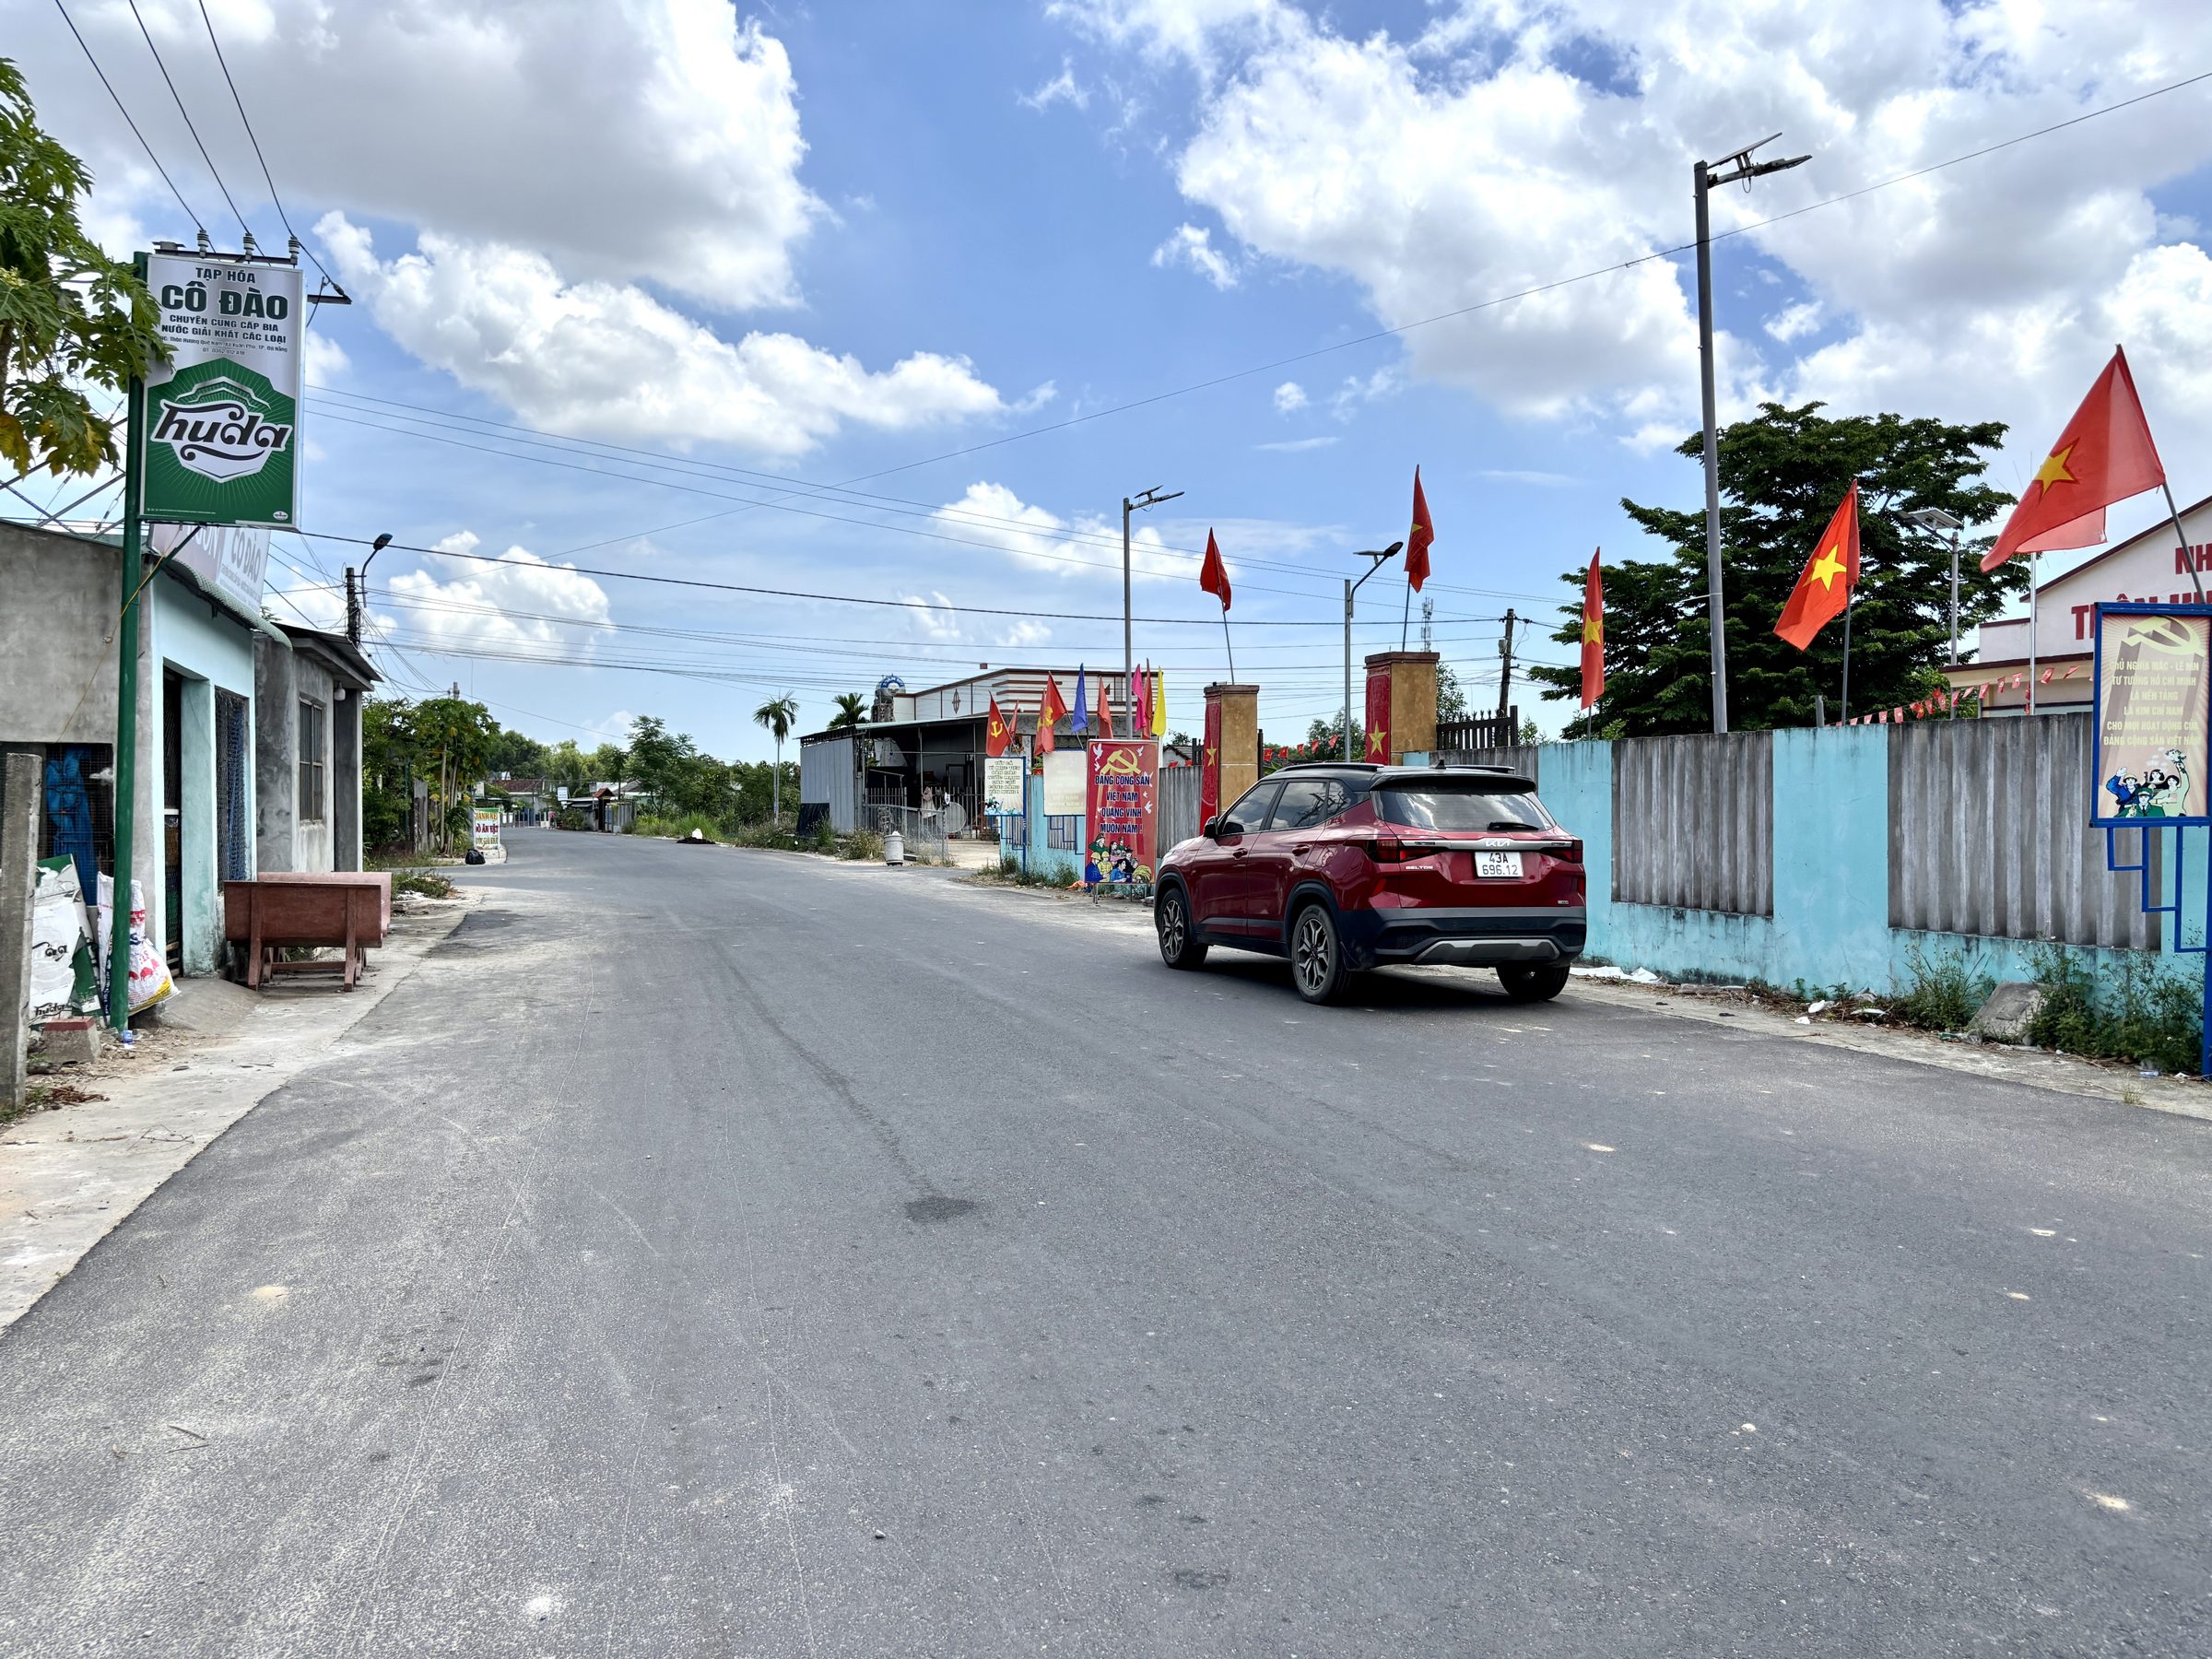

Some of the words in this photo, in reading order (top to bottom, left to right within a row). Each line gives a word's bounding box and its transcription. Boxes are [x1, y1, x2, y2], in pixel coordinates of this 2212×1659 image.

[195, 267, 222, 282] TẠP
[227, 269, 256, 284] HÓA
[161, 280, 207, 312] CÔ
[218, 287, 288, 321] ĐÀO
[169, 314, 208, 325] CHUYÊN
[210, 318, 237, 328] CUNG
[262, 323, 278, 332] BIA
[161, 324, 189, 335] NƯỚC
[192, 325, 211, 336] GIẢI
[214, 328, 239, 339] KHÁT
[242, 331, 262, 341] CÁC
[265, 335, 287, 345] LOẠI
[154, 402, 289, 448] huda
[2107, 721, 2123, 731] CHO
[2103, 733, 2124, 746] ĐẢNG
[1094, 774, 1114, 785] ĐẢNG
[1115, 774, 1135, 786] CỘNG
[1135, 774, 1150, 785] SẢN
[1106, 790, 1121, 803] VIỆT
[1122, 792, 1139, 802] NAM
[1101, 807, 1124, 818] QUANG
[1125, 807, 1143, 818] VINH
[1100, 821, 1121, 833] MUÔN
[1122, 821, 1139, 833] NĂM
[1488, 853, 1509, 864] 43A
[1482, 865, 1519, 876] 696.12
